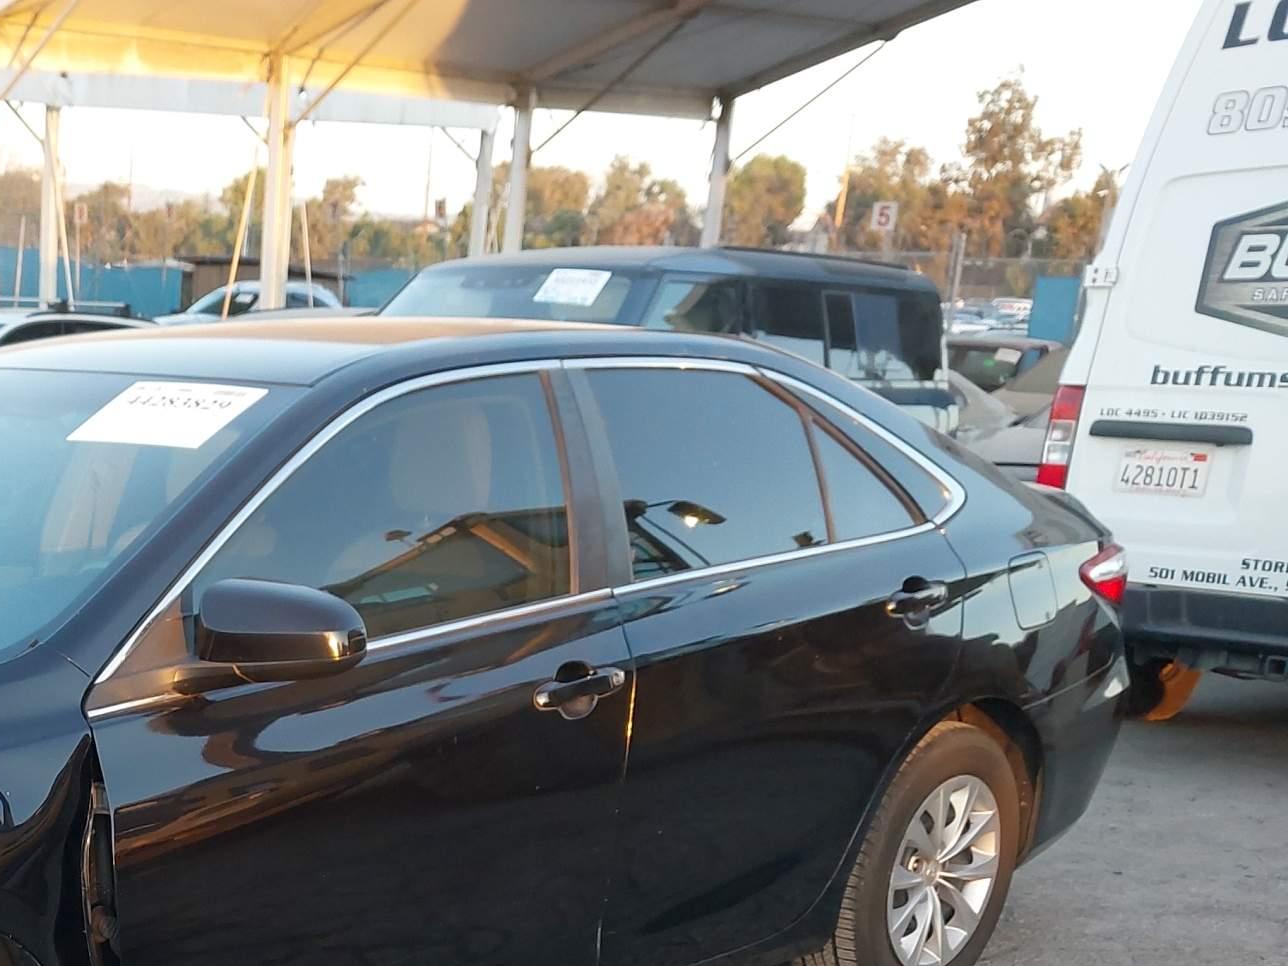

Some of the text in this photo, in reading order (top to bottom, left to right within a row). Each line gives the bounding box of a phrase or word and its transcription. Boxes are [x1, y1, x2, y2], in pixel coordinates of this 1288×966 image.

[1207, 85, 1288, 135] 80
[877, 205, 890, 226] 5
[1125, 408, 1158, 418] 4495
[1120, 464, 1199, 489] 42810T1
[1181, 570, 1230, 585] MOBIL
